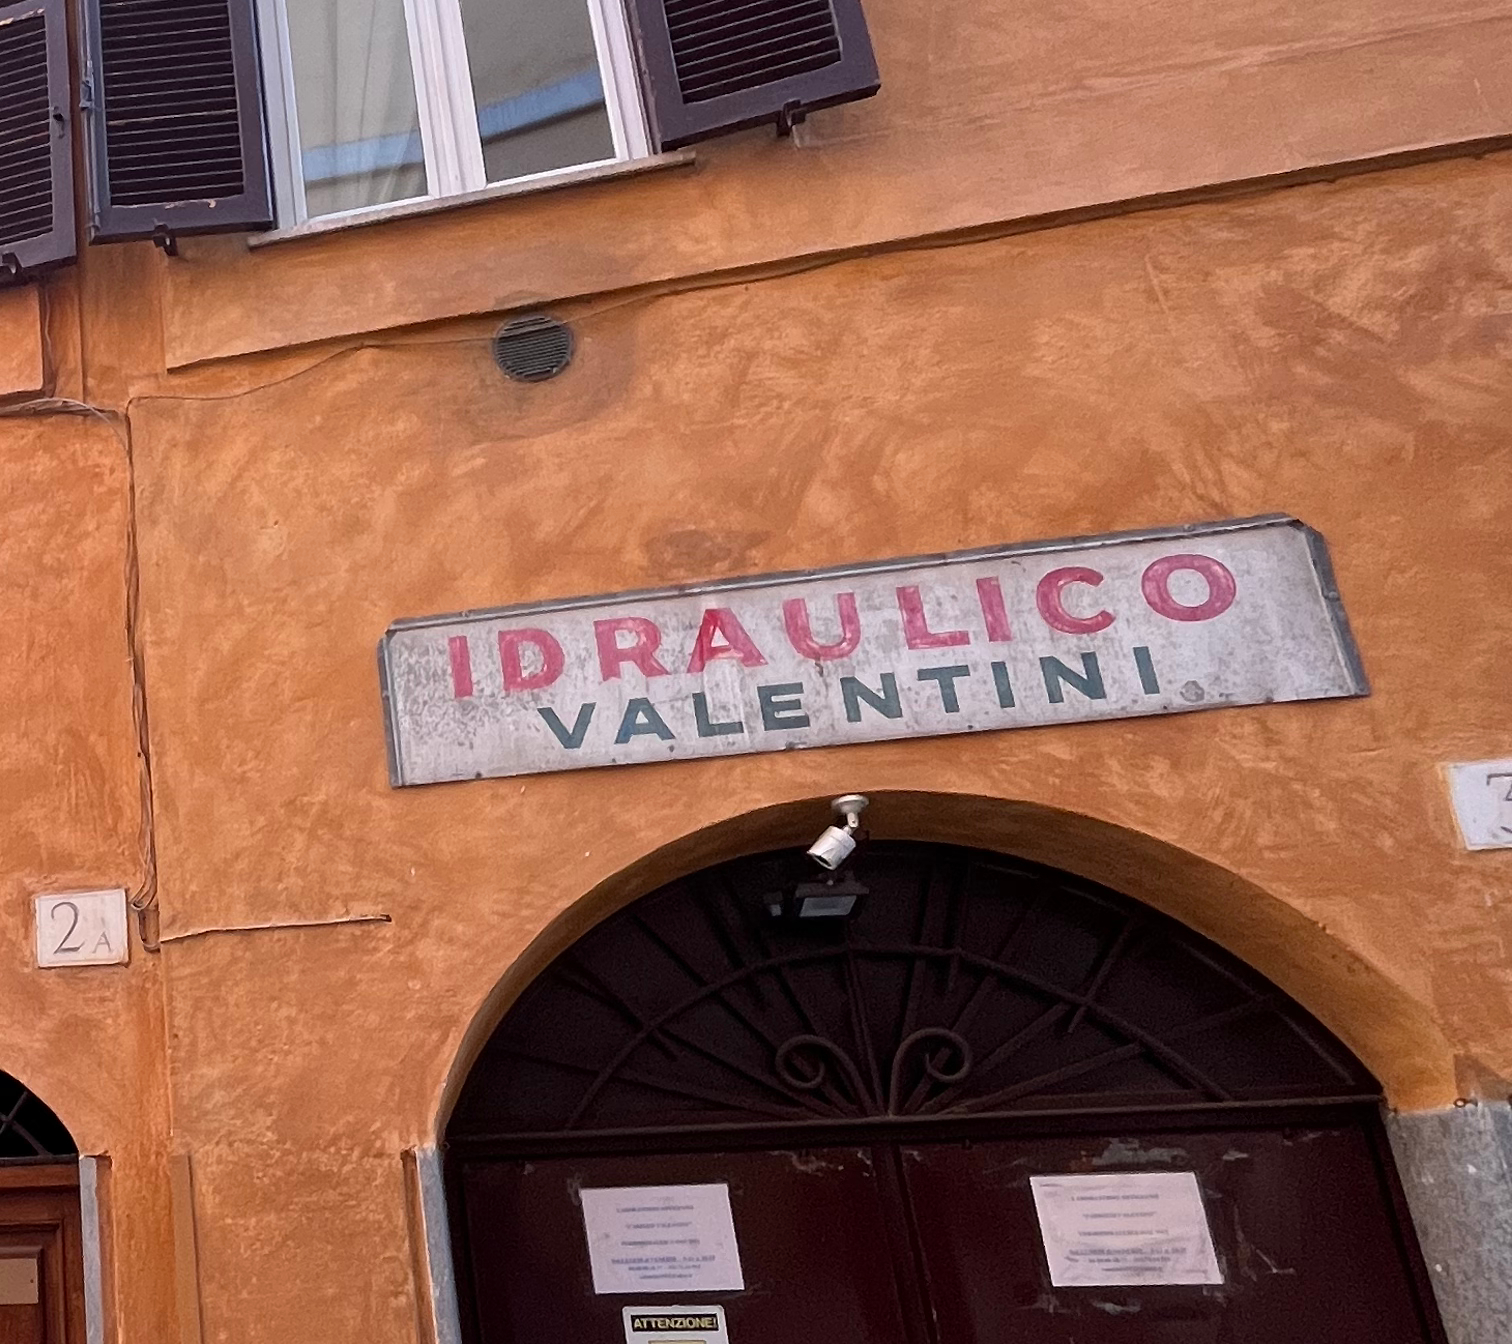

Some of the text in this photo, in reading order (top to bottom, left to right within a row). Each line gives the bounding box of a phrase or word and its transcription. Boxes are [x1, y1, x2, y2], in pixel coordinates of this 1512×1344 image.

[448, 552, 1238, 699] IDRAULICO
[536, 646, 1161, 750] VALENTINI
[633, 1317, 717, 1329] ATTENZIONE!
